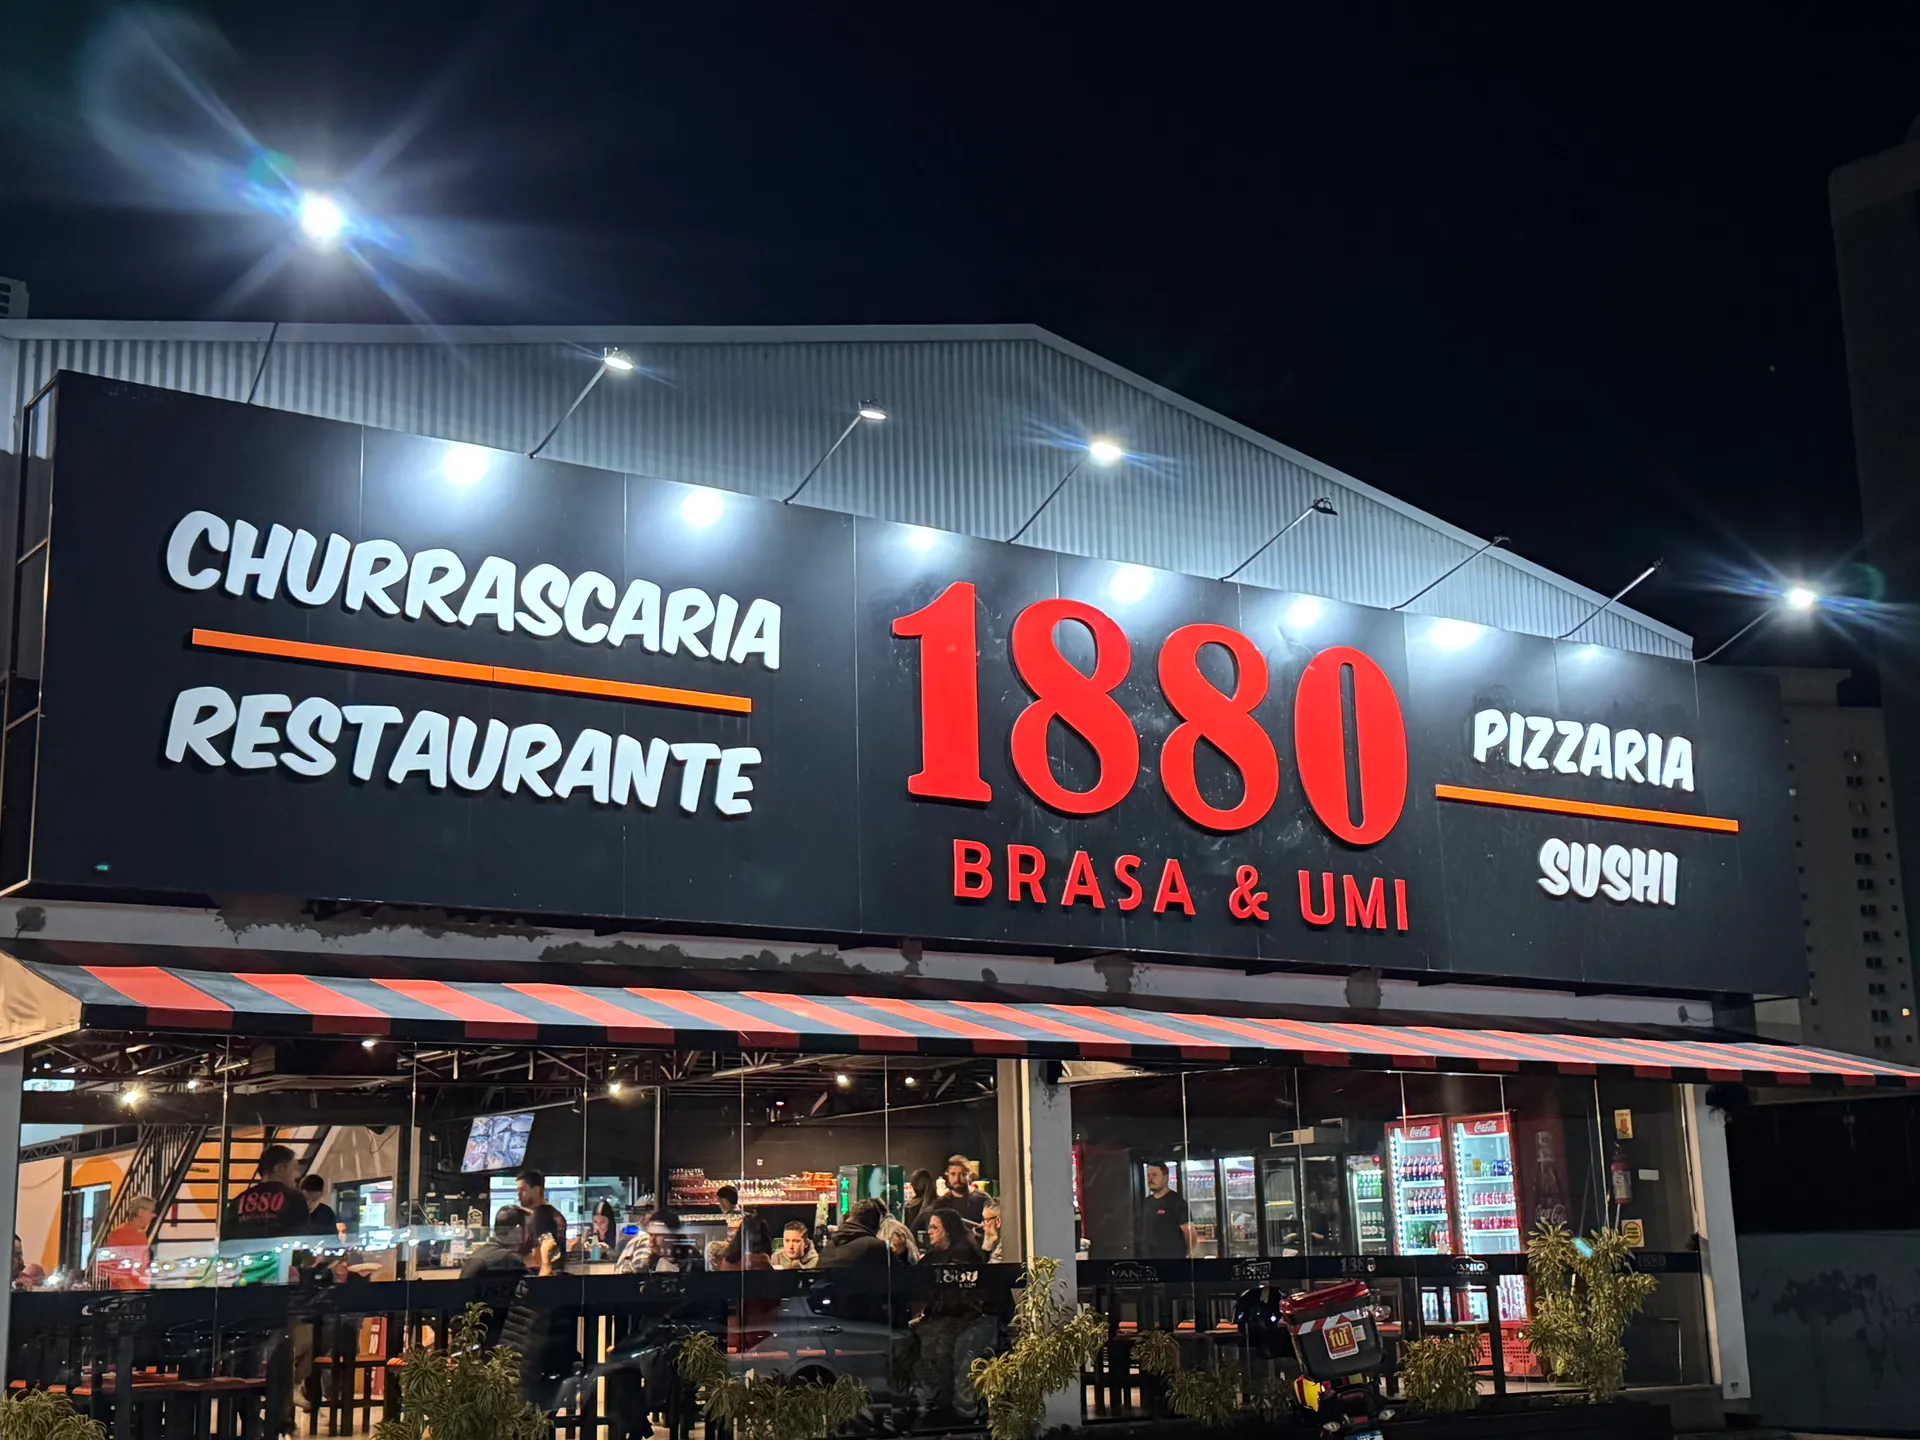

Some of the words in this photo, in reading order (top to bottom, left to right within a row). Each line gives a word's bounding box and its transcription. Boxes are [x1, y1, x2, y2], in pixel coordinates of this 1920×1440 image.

[166, 509, 782, 671] CHURRASCARIA
[164, 686, 762, 816] RESTAURANTE
[891, 581, 1409, 846] 1880
[1473, 708, 1695, 793] PIZZARIA
[953, 838, 1196, 916] BRASA
[1228, 864, 1270, 921] &
[1298, 870, 1409, 931] UMI
[1537, 837, 1679, 907] SUSHI
[238, 1191, 285, 1214] 1880
